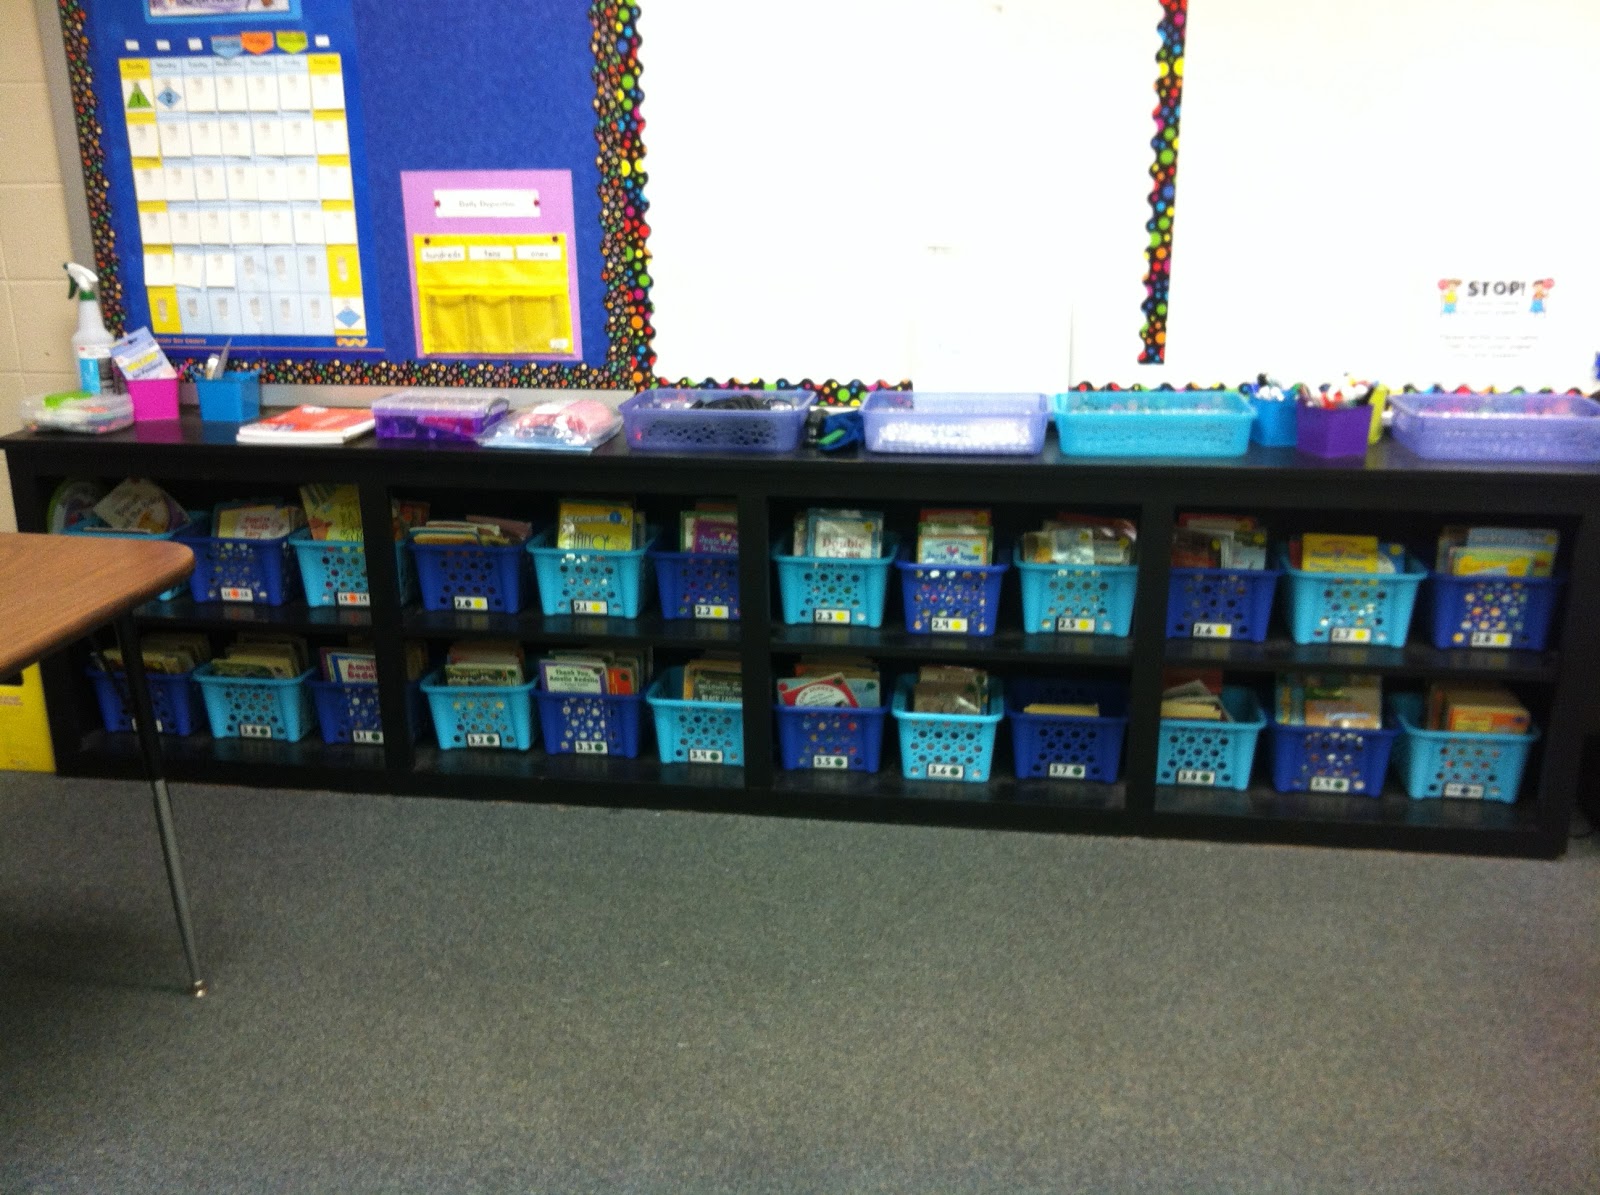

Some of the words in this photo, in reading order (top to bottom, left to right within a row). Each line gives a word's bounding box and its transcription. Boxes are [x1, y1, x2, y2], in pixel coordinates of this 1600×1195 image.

[1467, 280, 1526, 297] STOP!
[696, 606, 711, 616] 2.2
[817, 612, 833, 621] 2.3
[933, 619, 950, 629] 2.4
[1060, 619, 1076, 629] 2.5
[577, 742, 592, 752] 3.3
[692, 750, 707, 760] 3.4
[816, 756, 831, 766] 3.5
[931, 765, 946, 775] 3.6
